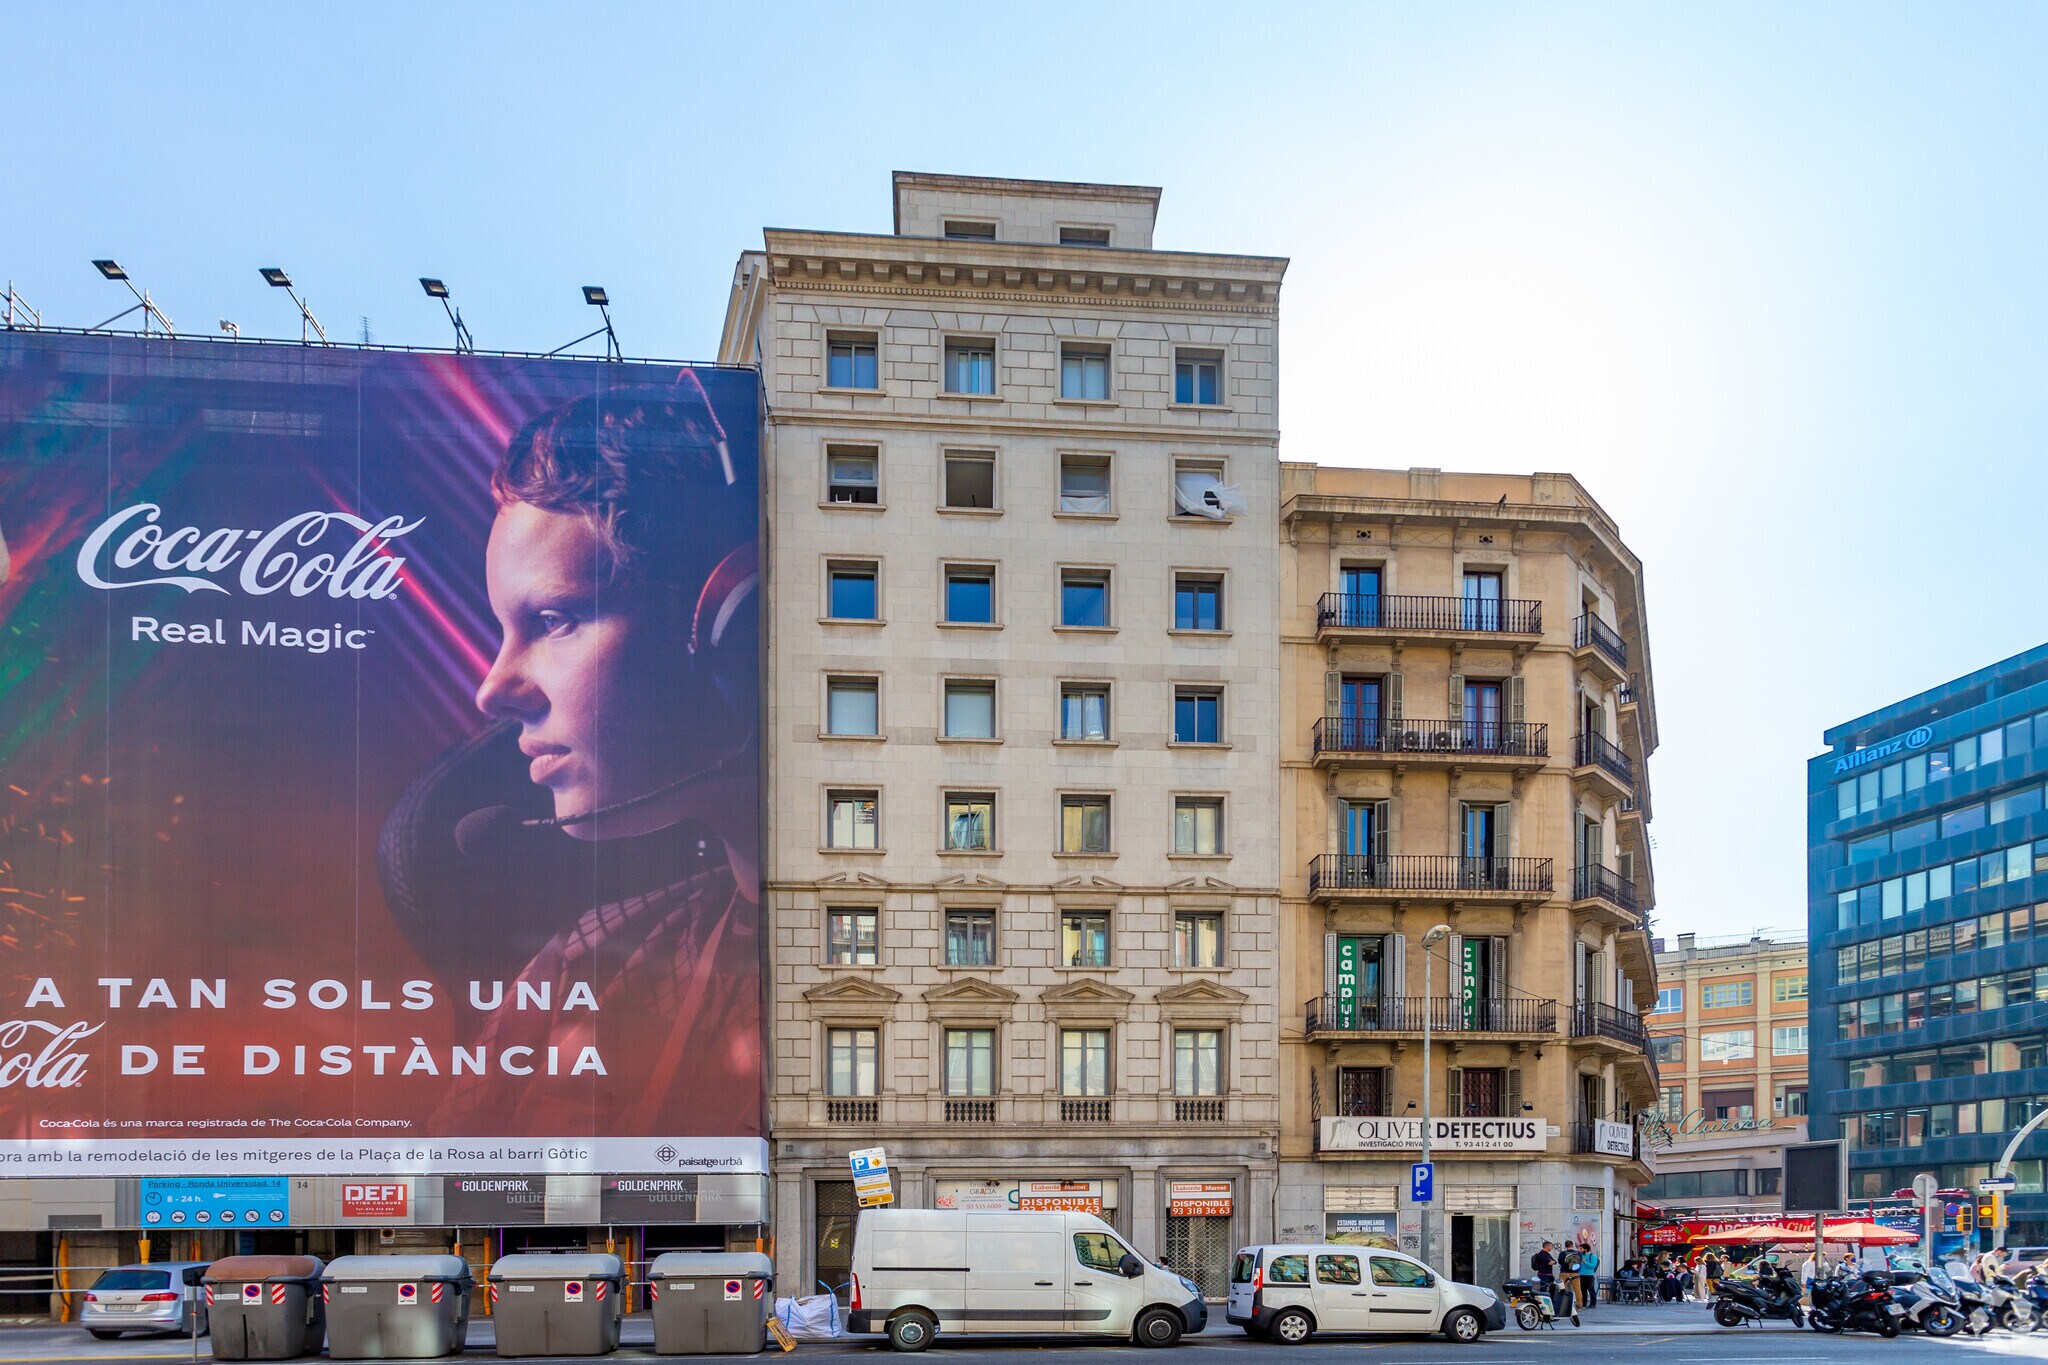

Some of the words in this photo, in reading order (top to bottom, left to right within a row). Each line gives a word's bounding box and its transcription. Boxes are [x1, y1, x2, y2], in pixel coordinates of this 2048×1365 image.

[77, 503, 427, 600] Coca-Cola
[131, 616, 226, 645] Real
[1834, 740, 1904, 775] Allianz
[24, 977, 66, 1008] A
[97, 978, 227, 1009] TAN
[262, 978, 434, 1010] SOLS
[469, 980, 600, 1011] UNA
[1338, 945, 1356, 1029] campus
[121, 1045, 206, 1076] DE
[243, 1036, 608, 1076] DISTÀNCIA
[39, 1119, 100, 1128] Coca-Cola
[103, 1119, 117, 1128] és
[120, 1120, 143, 1128] una
[146, 1120, 184, 1128] marca
[187, 1118, 248, 1129] registrada
[250, 1118, 267, 1127] de
[269, 1118, 292, 1127] The
[294, 1118, 353, 1127] Coca-Cola
[355, 1118, 413, 1128] Company.
[1436, 1121, 1536, 1140] DETECTIUS
[1608, 1125, 1629, 1140] OLIVER
[785, 1144, 795, 1152] 12
[1258, 1142, 1267, 1151] 12
[1358, 1139, 1404, 1148] INVESTIGACIÓ
[1607, 1140, 1630, 1153] DETECTIUS
[27, 1150, 63, 1162] amb
[68, 1150, 83, 1162] la
[87, 1149, 187, 1162] remodelació
[191, 1149, 211, 1161] de
[215, 1149, 238, 1161] les
[243, 1149, 312, 1164] mitgeres
[316, 1149, 336, 1161] de
[340, 1149, 354, 1161] la
[359, 1148, 401, 1163] Plaça
[405, 1148, 425, 1160] de
[429, 1148, 443, 1160] la
[447, 1148, 485, 1160] Rosa
[489, 1148, 503, 1160] al
[508, 1148, 543, 1160] barri
[548, 1147, 588, 1160] Gòtic
[855, 1158, 865, 1170] P
[1415, 1167, 1429, 1187] P
[148, 1180, 180, 1189] Parking
[188, 1180, 215, 1188] Ronda
[297, 1181, 308, 1189] 14
[166, 1195, 173, 1203] 8
[181, 1195, 193, 1203] 24
[194, 1195, 204, 1203] h.
[345, 1185, 404, 1201] DEFI
[1021, 1198, 1100, 1206] DISPONIBLE
[1173, 1207, 1184, 1215] 93
[1187, 1207, 1203, 1215] 318
[1205, 1207, 1217, 1215] 36
[1219, 1207, 1230, 1215] 63
